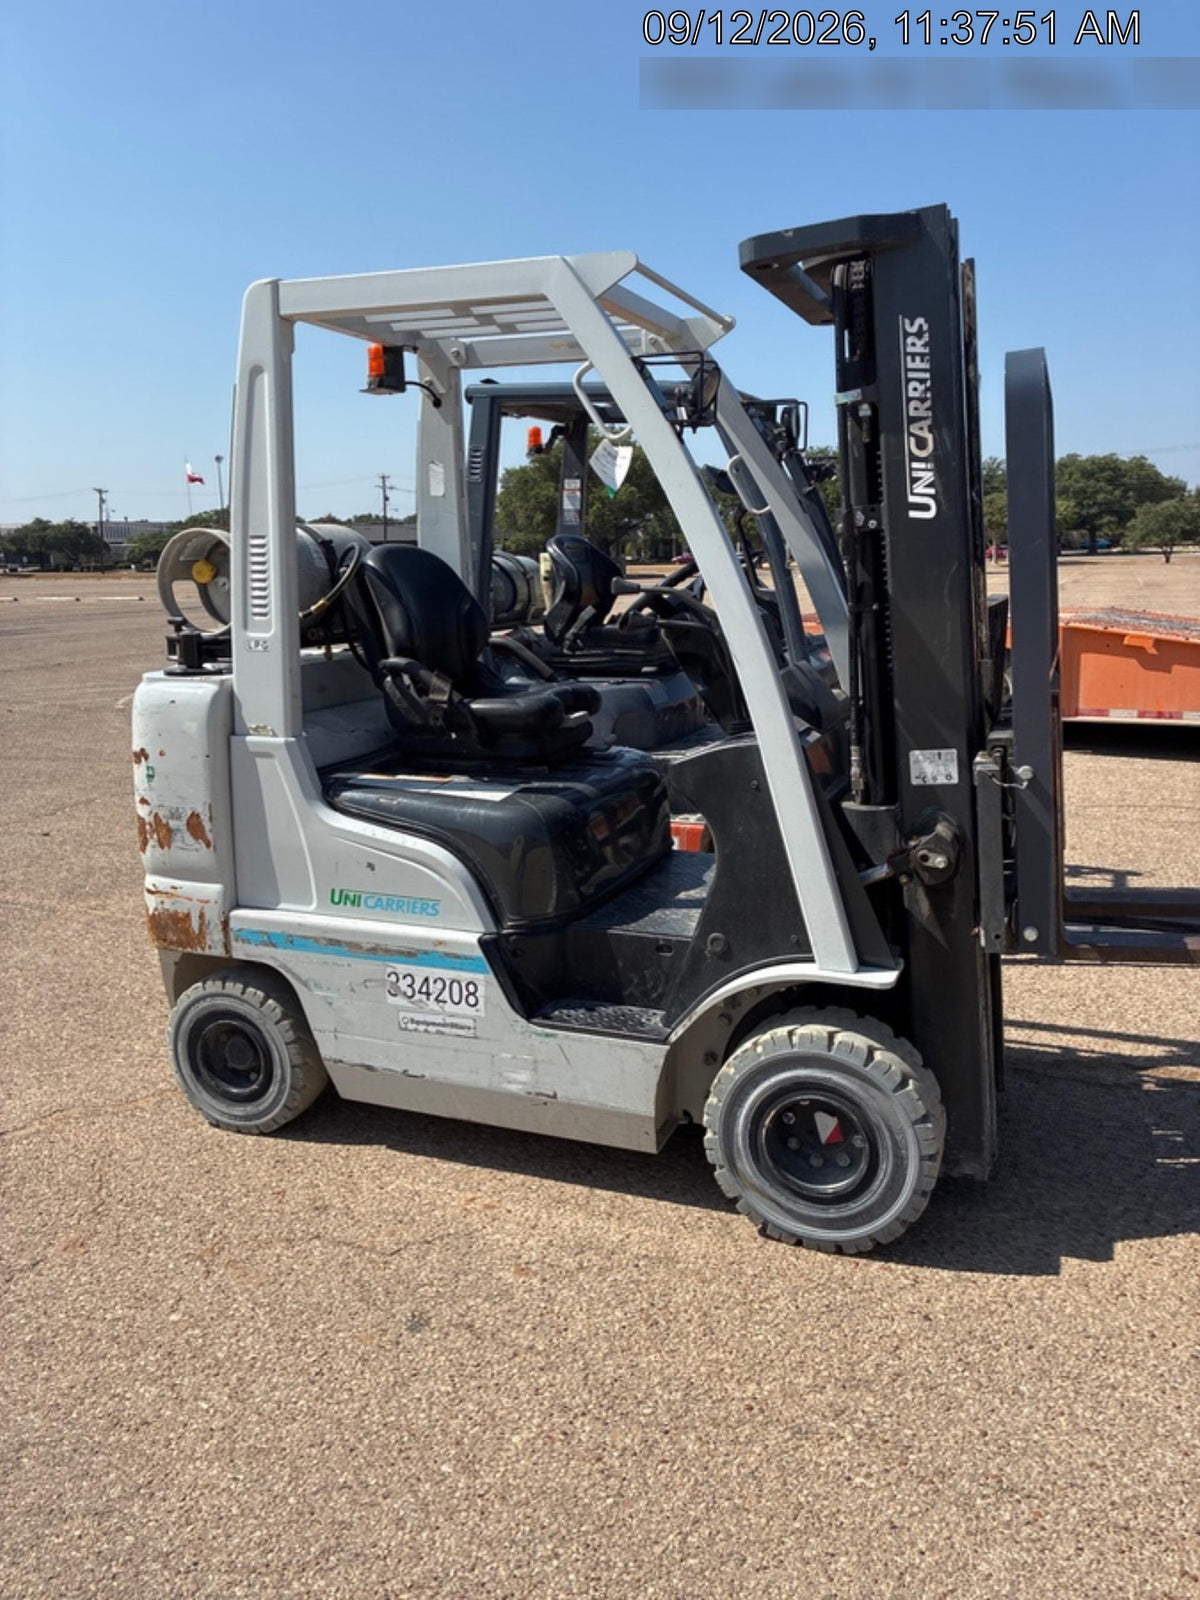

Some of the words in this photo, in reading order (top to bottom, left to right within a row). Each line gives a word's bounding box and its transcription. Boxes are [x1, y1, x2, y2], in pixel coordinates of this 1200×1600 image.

[903, 316, 937, 520] UNICARRIERS
[330, 887, 440, 917] UNICARRIERS
[386, 971, 480, 1009] 334208
